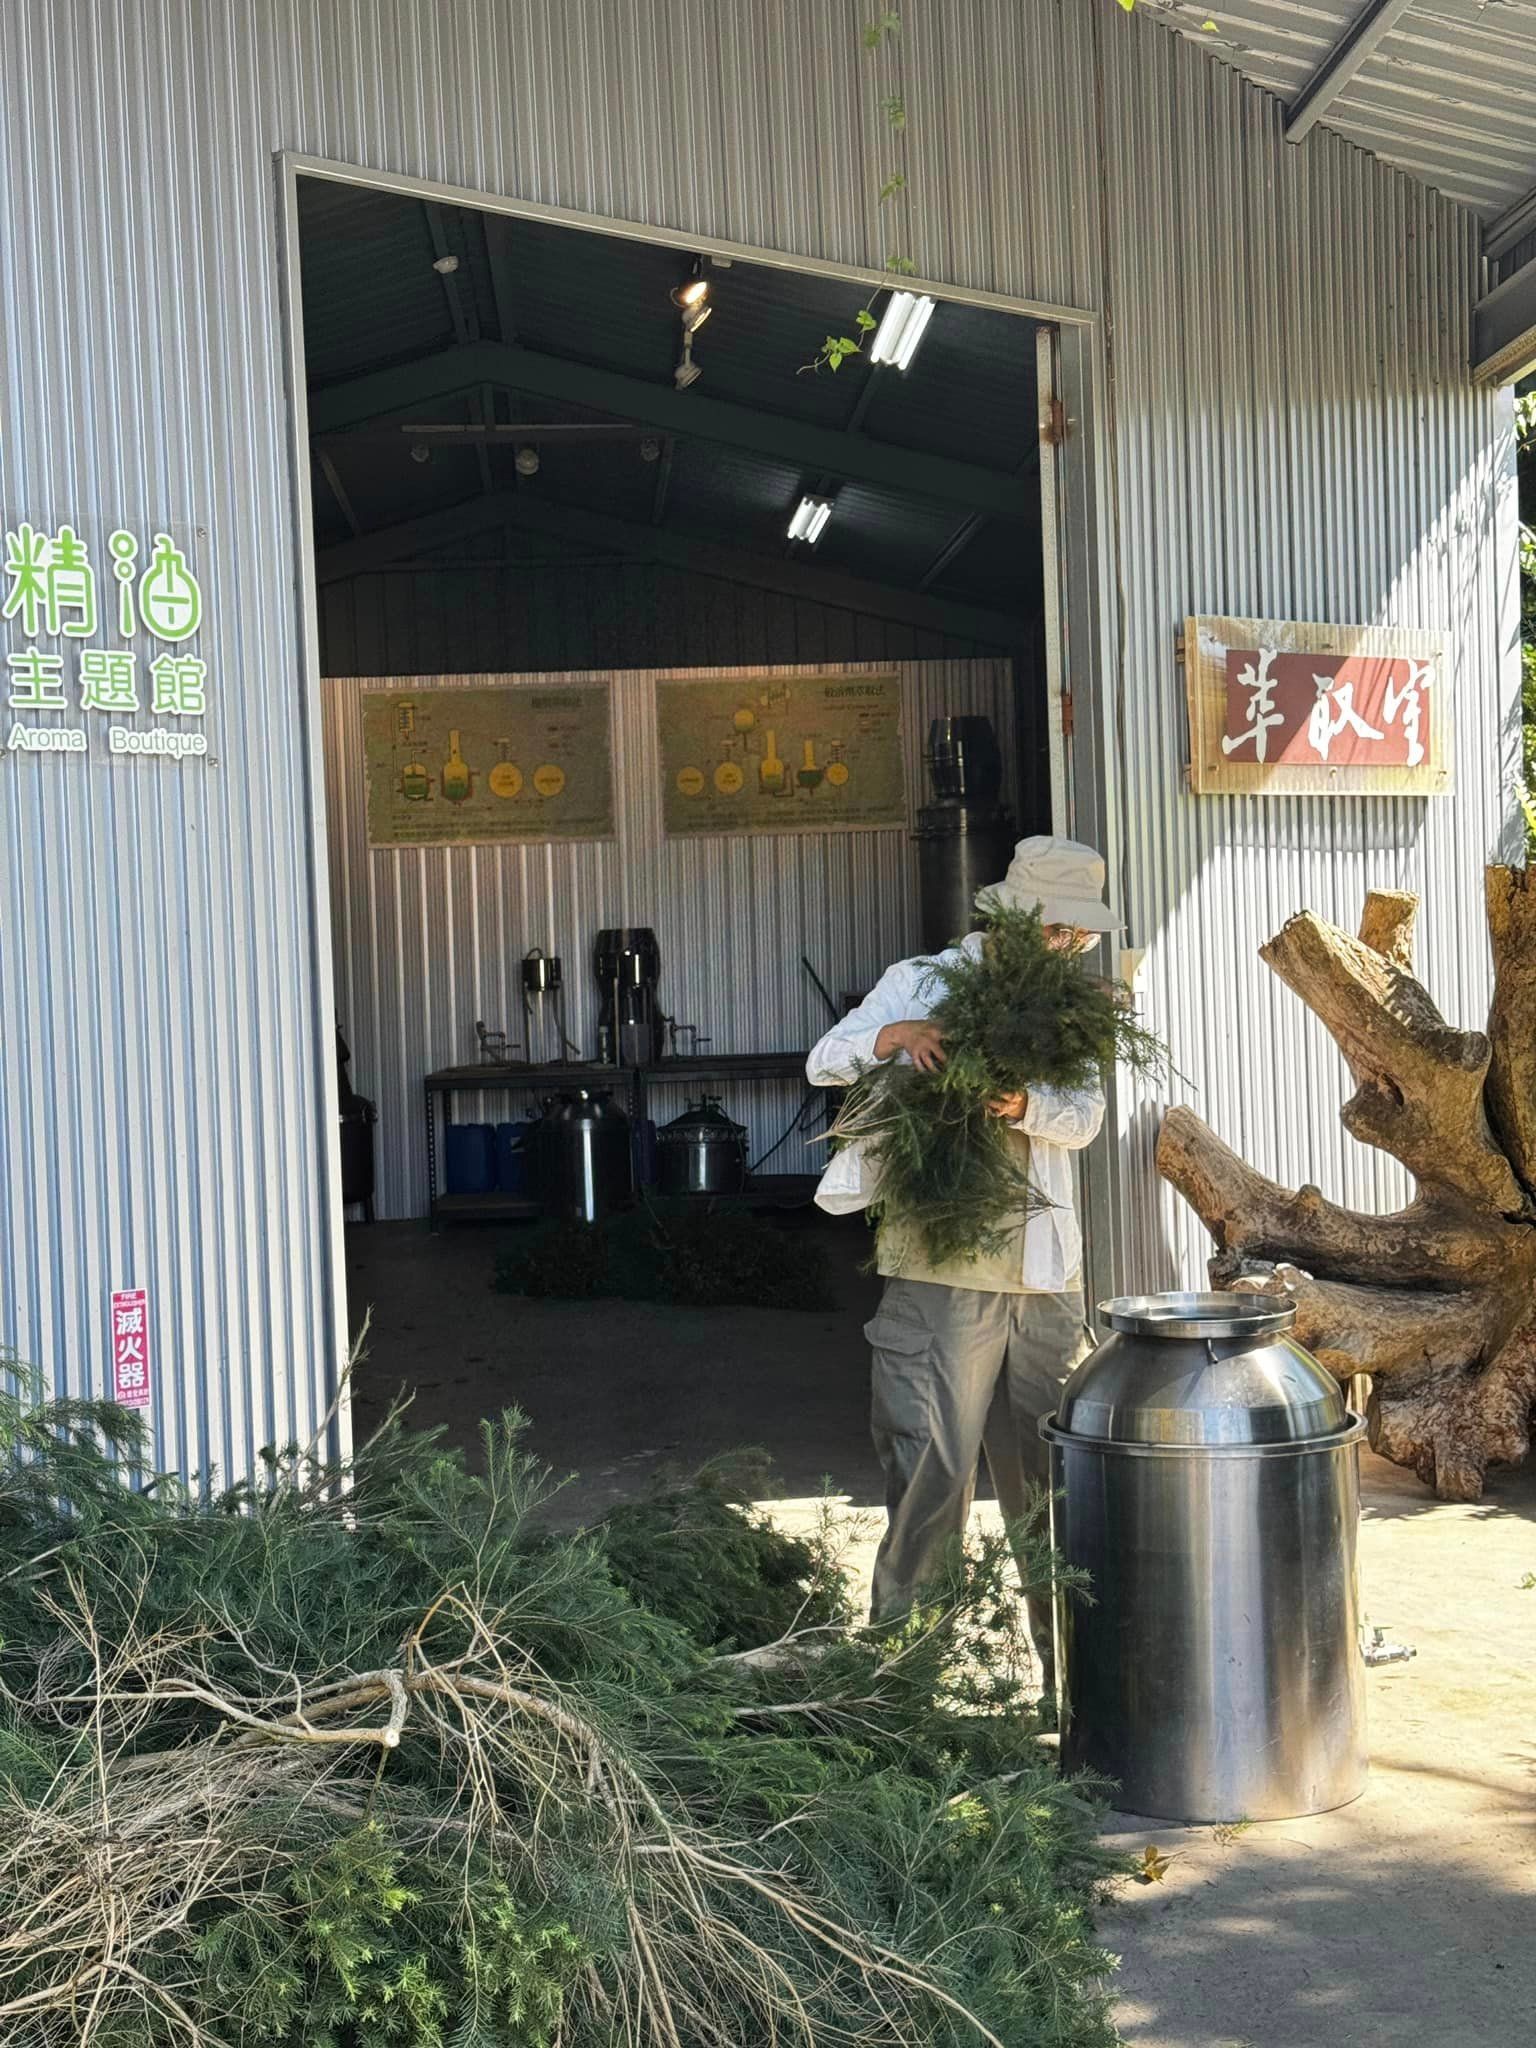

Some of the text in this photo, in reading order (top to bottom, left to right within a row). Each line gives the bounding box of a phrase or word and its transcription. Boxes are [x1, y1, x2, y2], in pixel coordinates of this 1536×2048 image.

[3, 524, 200, 640] 精油
[8, 649, 205, 713] 主題館
[10, 726, 205, 756] Aroma Boutique
[115, 1307, 146, 1389] 滅火器
